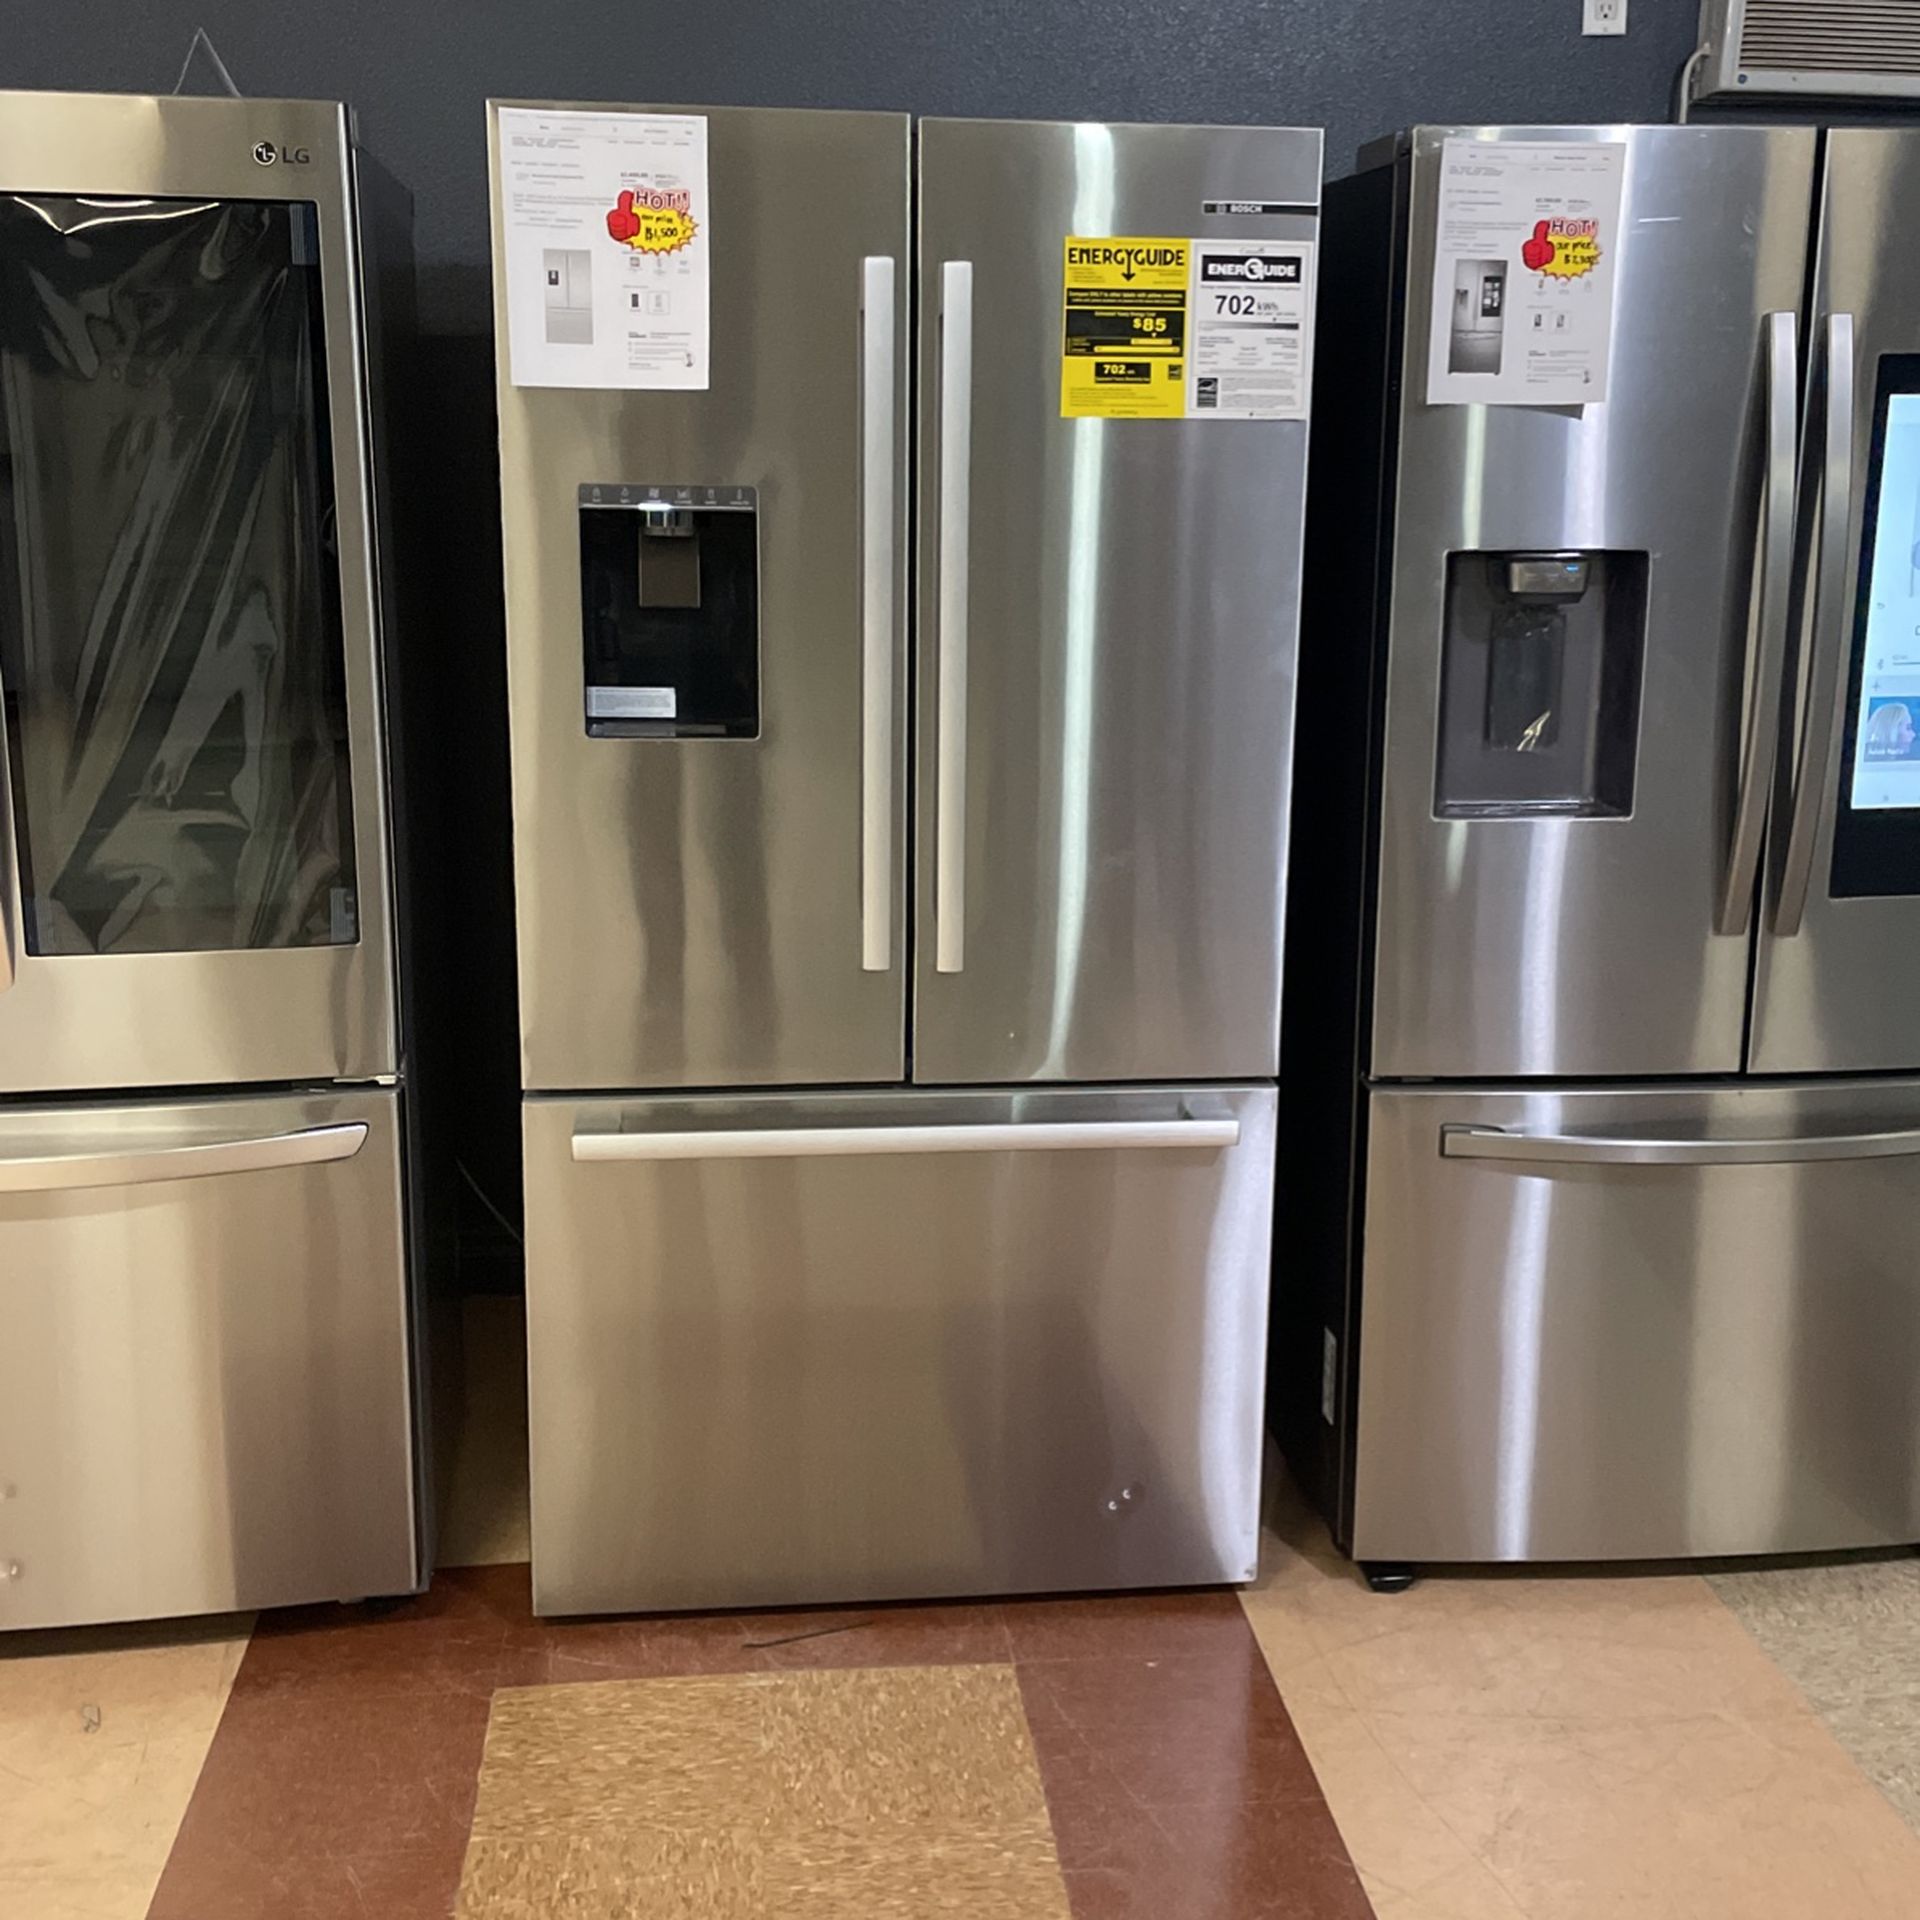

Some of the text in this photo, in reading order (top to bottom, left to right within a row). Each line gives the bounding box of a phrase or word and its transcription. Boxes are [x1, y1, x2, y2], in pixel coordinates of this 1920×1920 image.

[282, 146, 311, 164] LG
[1230, 204, 1262, 213] BOSCH
[1068, 247, 1185, 268] ENERGYGUIDE
[1214, 295, 1256, 316] 702
[1132, 317, 1167, 332] $85
[1103, 364, 1126, 375] 702
